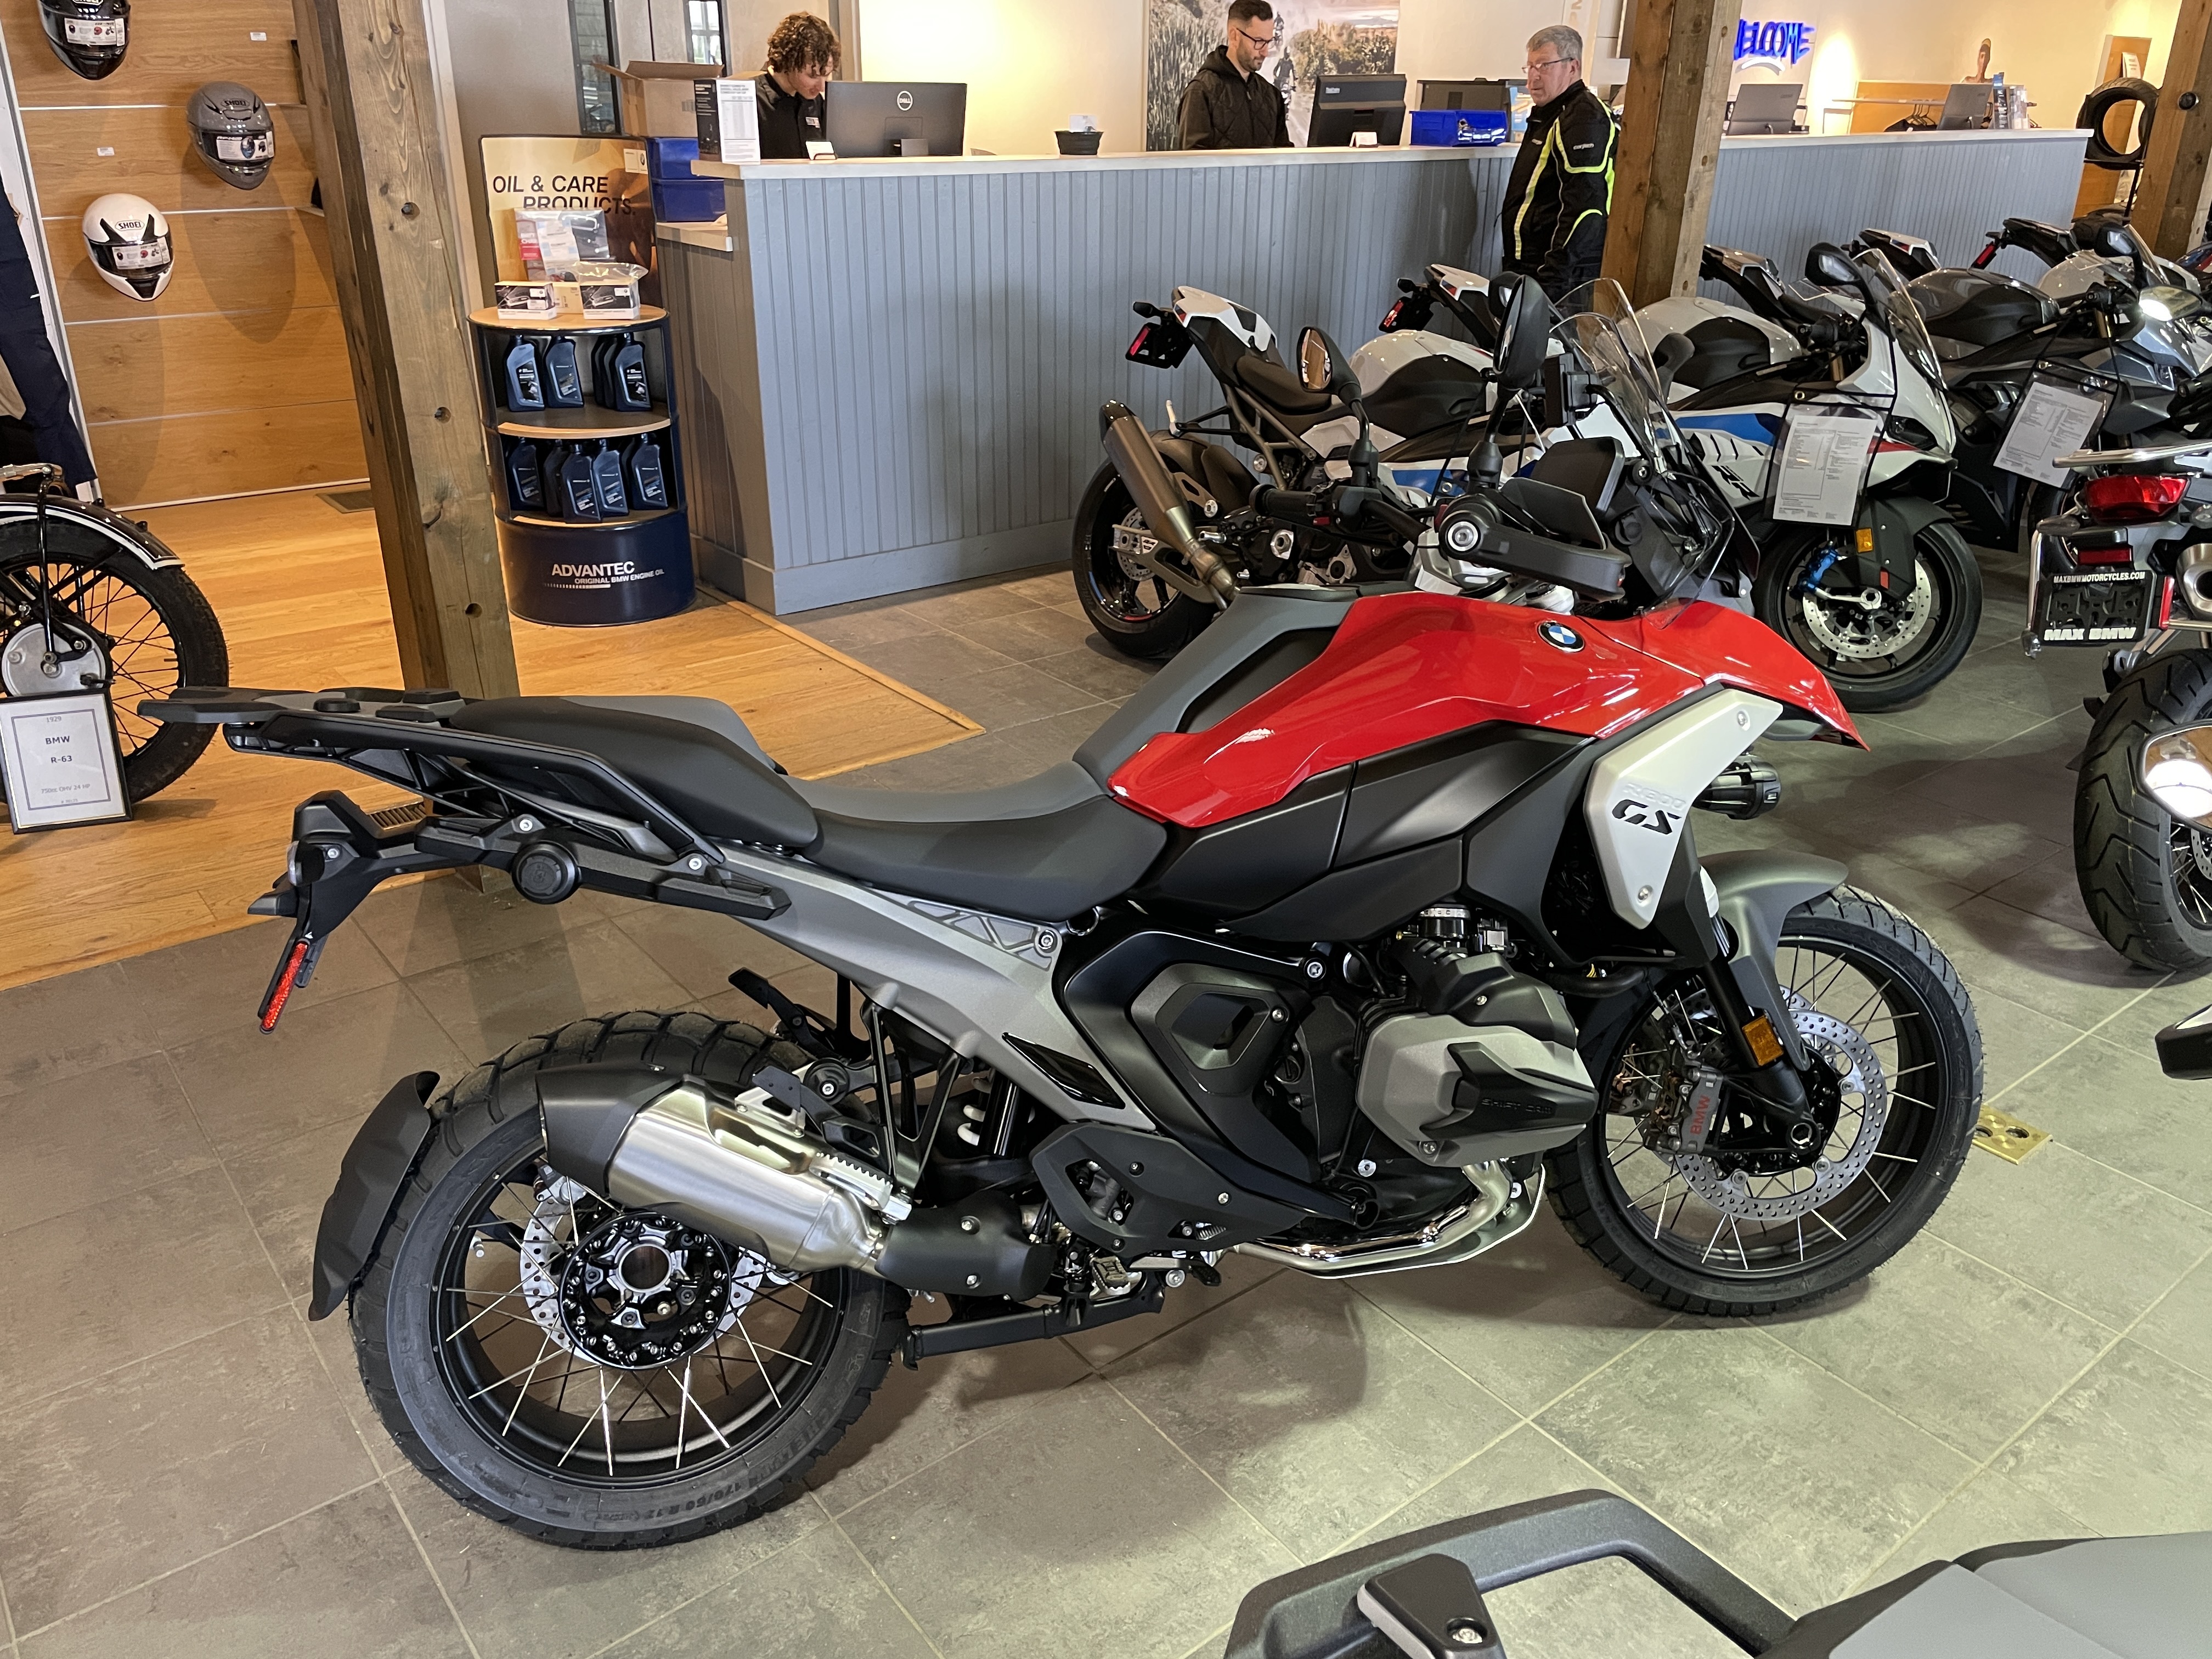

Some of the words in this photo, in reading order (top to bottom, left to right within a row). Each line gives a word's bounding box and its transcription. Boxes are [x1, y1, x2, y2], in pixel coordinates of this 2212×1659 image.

[493, 176, 524, 193] OIL
[531, 175, 544, 193] &
[552, 175, 608, 193] CARE
[523, 196, 636, 216] PRODUCTS.
[118, 221, 142, 229] SHOEI
[551, 561, 635, 577] ADVANTEC
[611, 575, 629, 583] BMW
[630, 571, 654, 581] ENGINE
[654, 568, 665, 577] OIL
[2053, 572, 2146, 583] MAXBMWMOTORCYCLES.COM
[2044, 628, 2085, 641] MAX
[2088, 627, 2137, 640] BMW
[45, 735, 70, 745] BMW
[50, 755, 72, 764] R-63
[1612, 799, 1683, 835] GS
[1690, 1094, 1711, 1135] BMW
